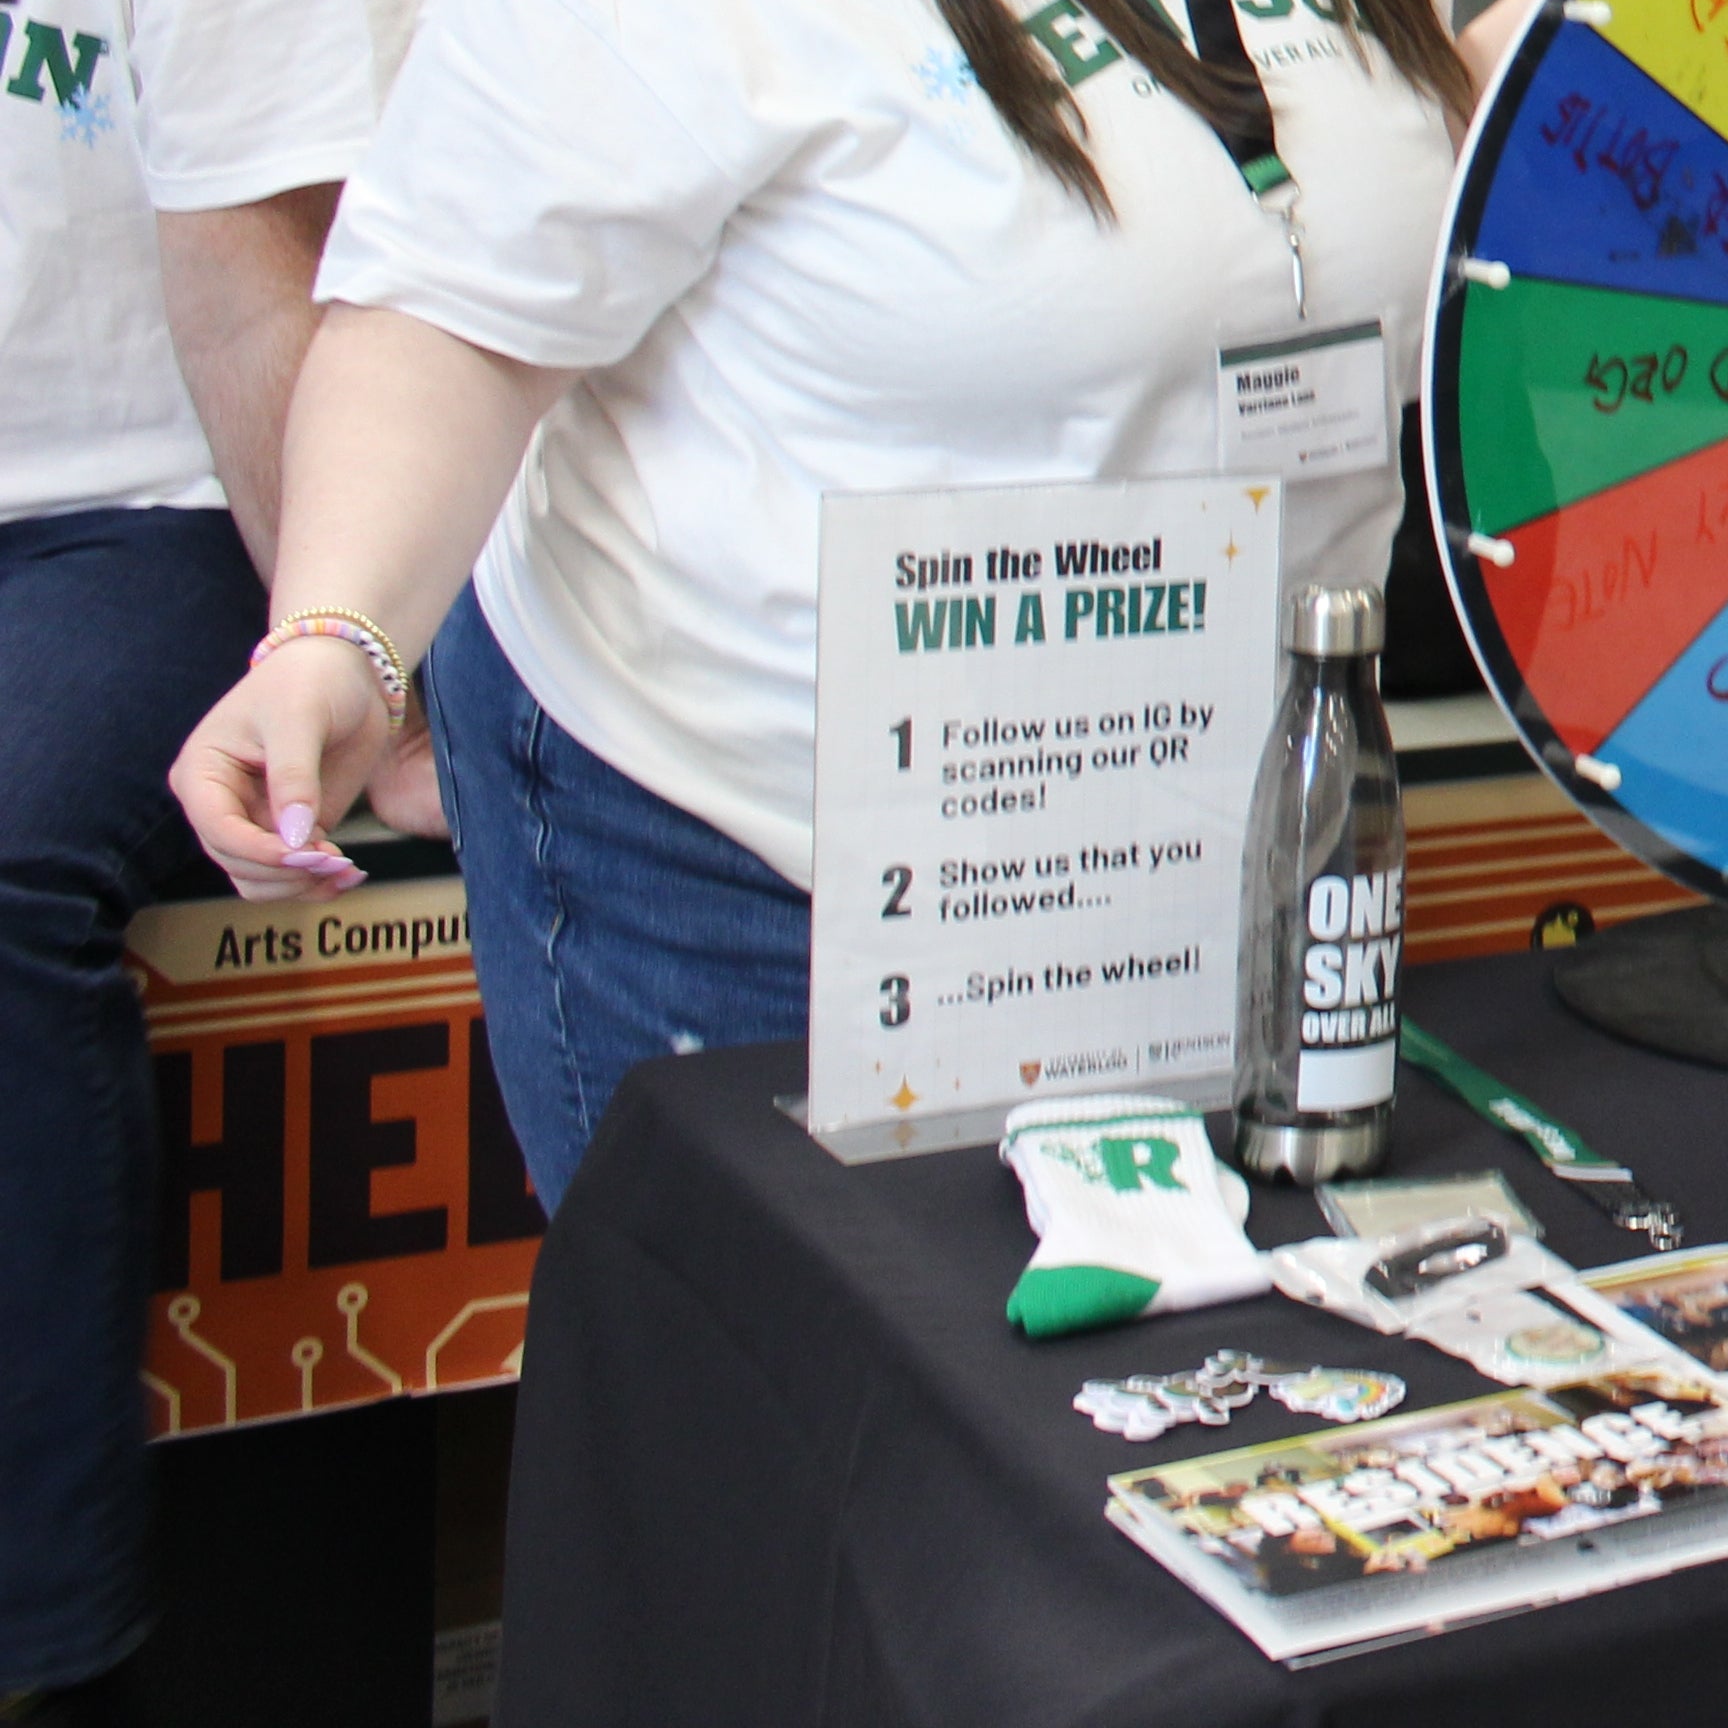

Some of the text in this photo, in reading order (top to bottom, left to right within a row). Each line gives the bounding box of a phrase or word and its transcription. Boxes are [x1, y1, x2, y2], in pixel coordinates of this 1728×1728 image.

[0, 11, 102, 110] N
[1254, 43, 1304, 69] VER
[896, 536, 1162, 591] Spin the Wheel
[895, 579, 1207, 654] WIN A PRIZE!
[889, 701, 1214, 772] 1 Follow us on IG by
[941, 736, 1190, 785] scanning our QR
[941, 783, 1047, 819] codes!
[881, 839, 1203, 920] 2 Show us that you
[1308, 865, 1403, 942] ONE
[214, 925, 303, 969] Arts
[1304, 932, 1401, 1010] SKY
[878, 972, 912, 1029] 3
[1045, 960, 1092, 992] the
[1101, 944, 1201, 983] wheel!
[1302, 1000, 1396, 1044] OVER ALL
[1101, 1137, 1190, 1191] R
